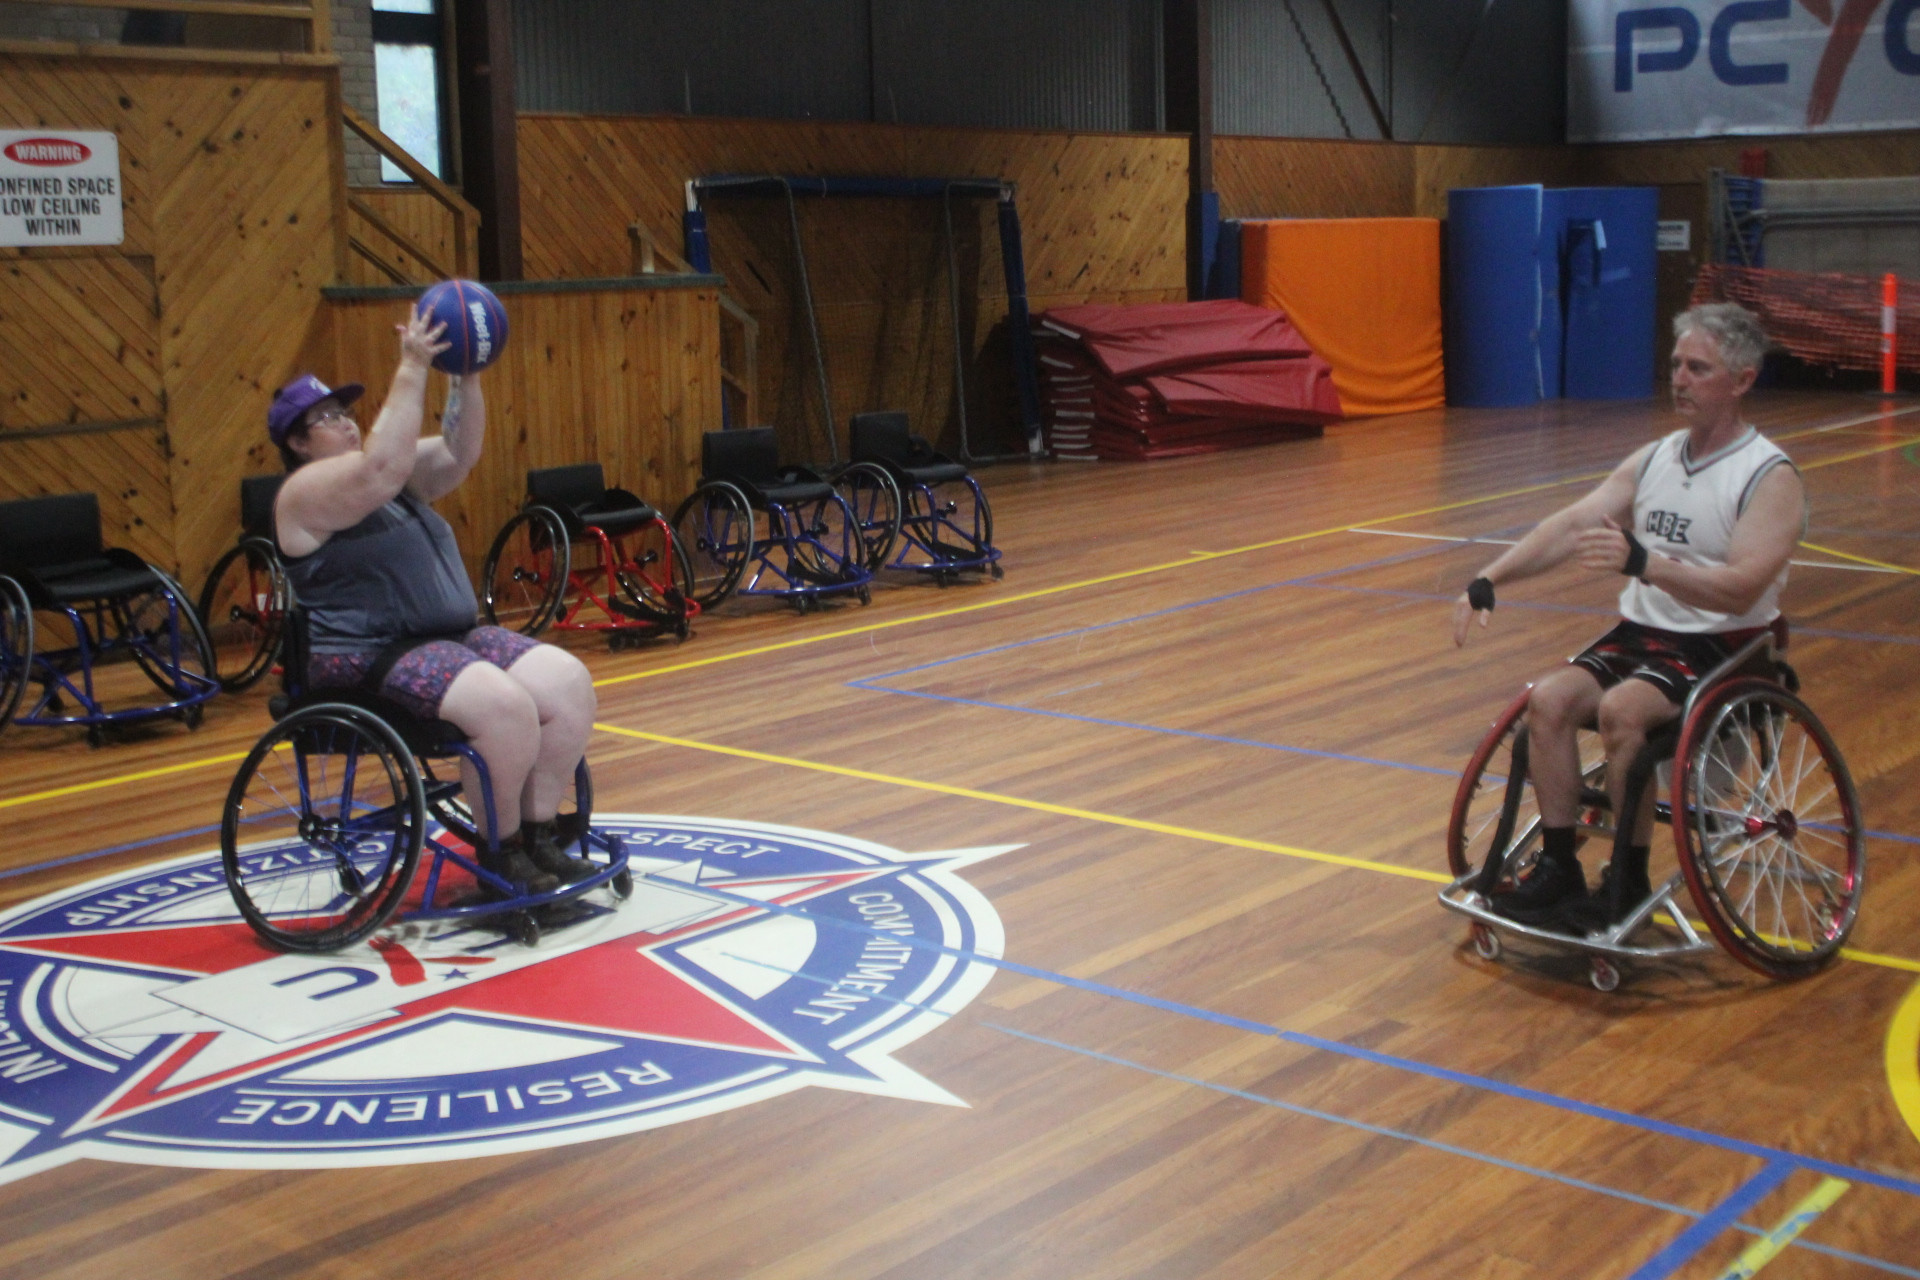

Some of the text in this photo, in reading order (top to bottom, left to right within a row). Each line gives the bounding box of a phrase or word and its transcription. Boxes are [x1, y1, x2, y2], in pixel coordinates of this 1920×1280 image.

[14, 144, 83, 161] WARNING
[68, 178, 115, 195] SPACE
[3, 198, 101, 216] LOW CEILING
[26, 218, 81, 236] WITHIN
[216, 1061, 673, 1126] RESILIENCE
